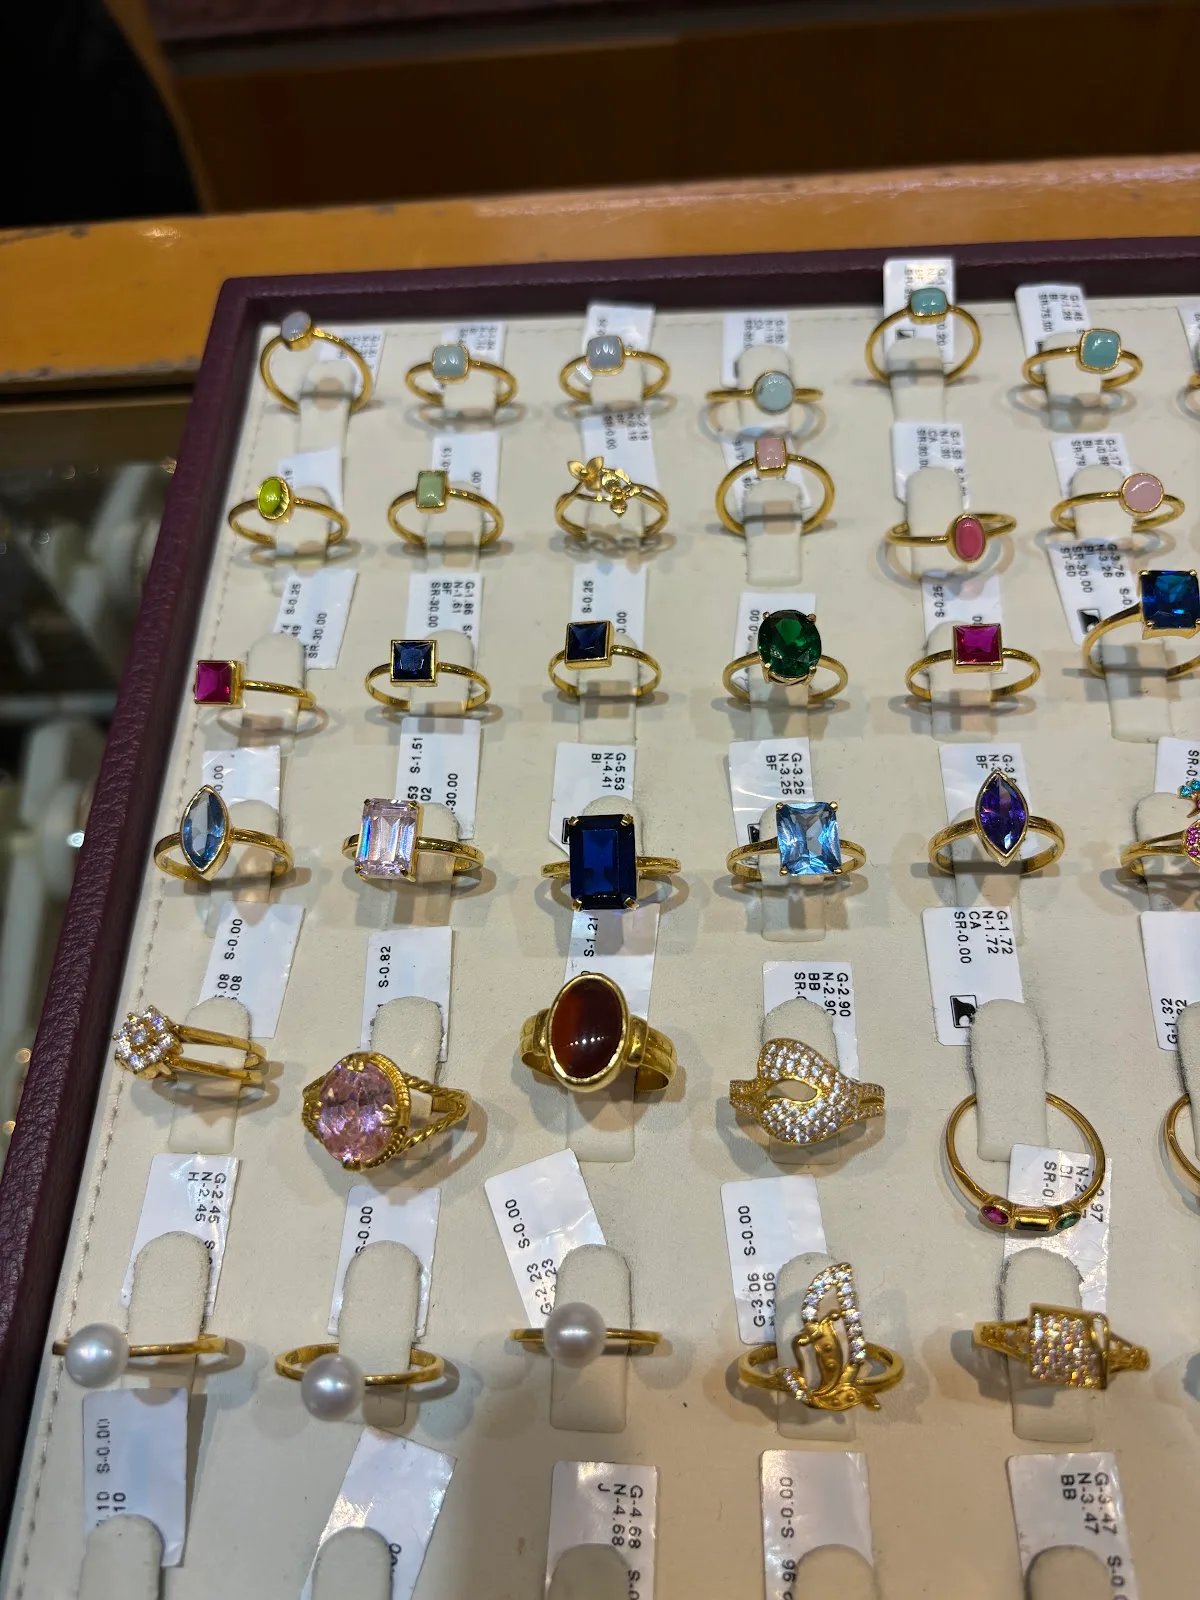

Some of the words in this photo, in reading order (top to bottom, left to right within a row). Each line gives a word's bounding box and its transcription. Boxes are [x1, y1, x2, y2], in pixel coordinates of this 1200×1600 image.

[409, 736, 424, 774] S-1.51
[590, 752, 602, 764] BI
[602, 751, 614, 790] N-4.41
[613, 751, 627, 791] G-5.53
[765, 754, 778, 771] BF
[777, 752, 793, 797] N-3.25
[790, 751, 806, 796] G-3.25
[975, 754, 988, 770] BF
[223, 917, 243, 960] S-0.00
[583, 915, 599, 958] S-1.21
[954, 910, 973, 965] SR-0.00
[968, 910, 982, 930] CA
[982, 909, 999, 955] N-1.72
[996, 909, 1014, 955] G-1.72
[378, 944, 392, 989] S-0.82
[808, 972, 821, 991] BB
[836, 971, 851, 1018] G-2.90
[1159, 997, 1178, 1045] G-1.32
[187, 1171, 200, 1183] H
[194, 1171, 212, 1223] N-2.45
[208, 1171, 227, 1225] G-2.45
[504, 1198, 531, 1249] S-0.00
[737, 1204, 757, 1256] S-0.00
[746, 1271, 765, 1328] G-3.06
[779, 1475, 795, 1539] S-0.00
[1060, 1473, 1077, 1501] BB
[1076, 1472, 1100, 1536] N-3.47
[1093, 1471, 1118, 1536] G-3.47
[611, 1483, 628, 1547] N-4.68
[628, 1484, 645, 1551] G-4.68
